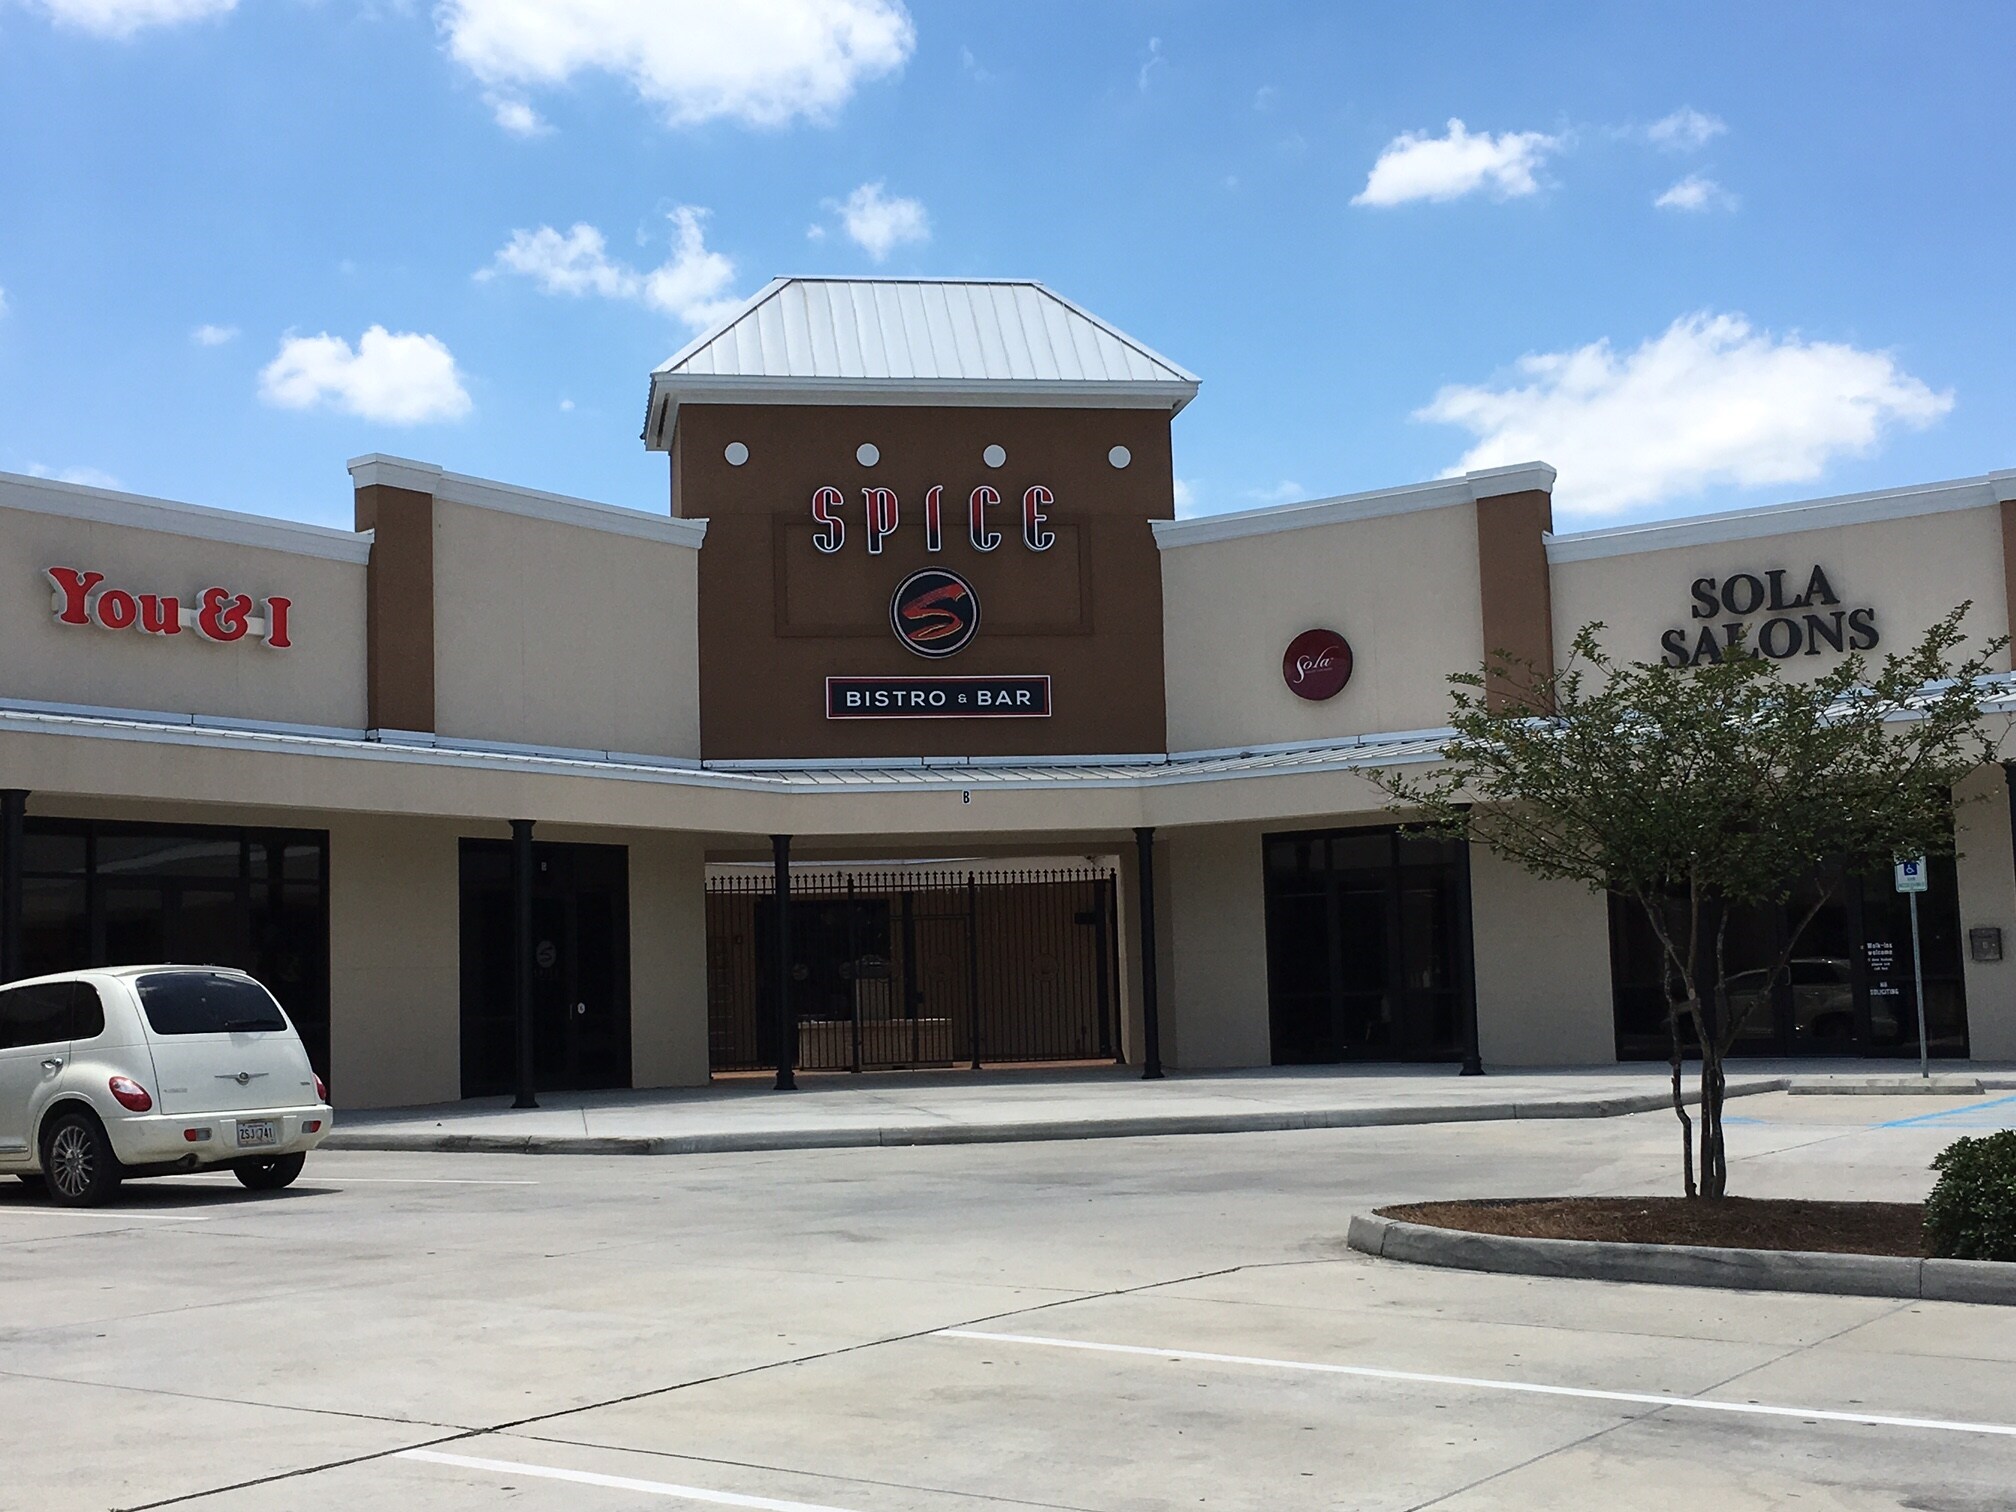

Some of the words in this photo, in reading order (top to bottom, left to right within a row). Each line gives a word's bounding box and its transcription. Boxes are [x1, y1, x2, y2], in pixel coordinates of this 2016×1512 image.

[812, 485, 1056, 554] SPICE
[45, 566, 182, 636] You
[194, 586, 253, 643] &
[261, 596, 293, 648] I
[1691, 564, 1841, 619] SOLA
[1293, 645, 1339, 684] Sola
[1660, 607, 1880, 669] SALONS
[846, 690, 946, 707] BISTRO
[957, 693, 968, 704] &
[977, 690, 1032, 706] BAR
[962, 790, 971, 805] B
